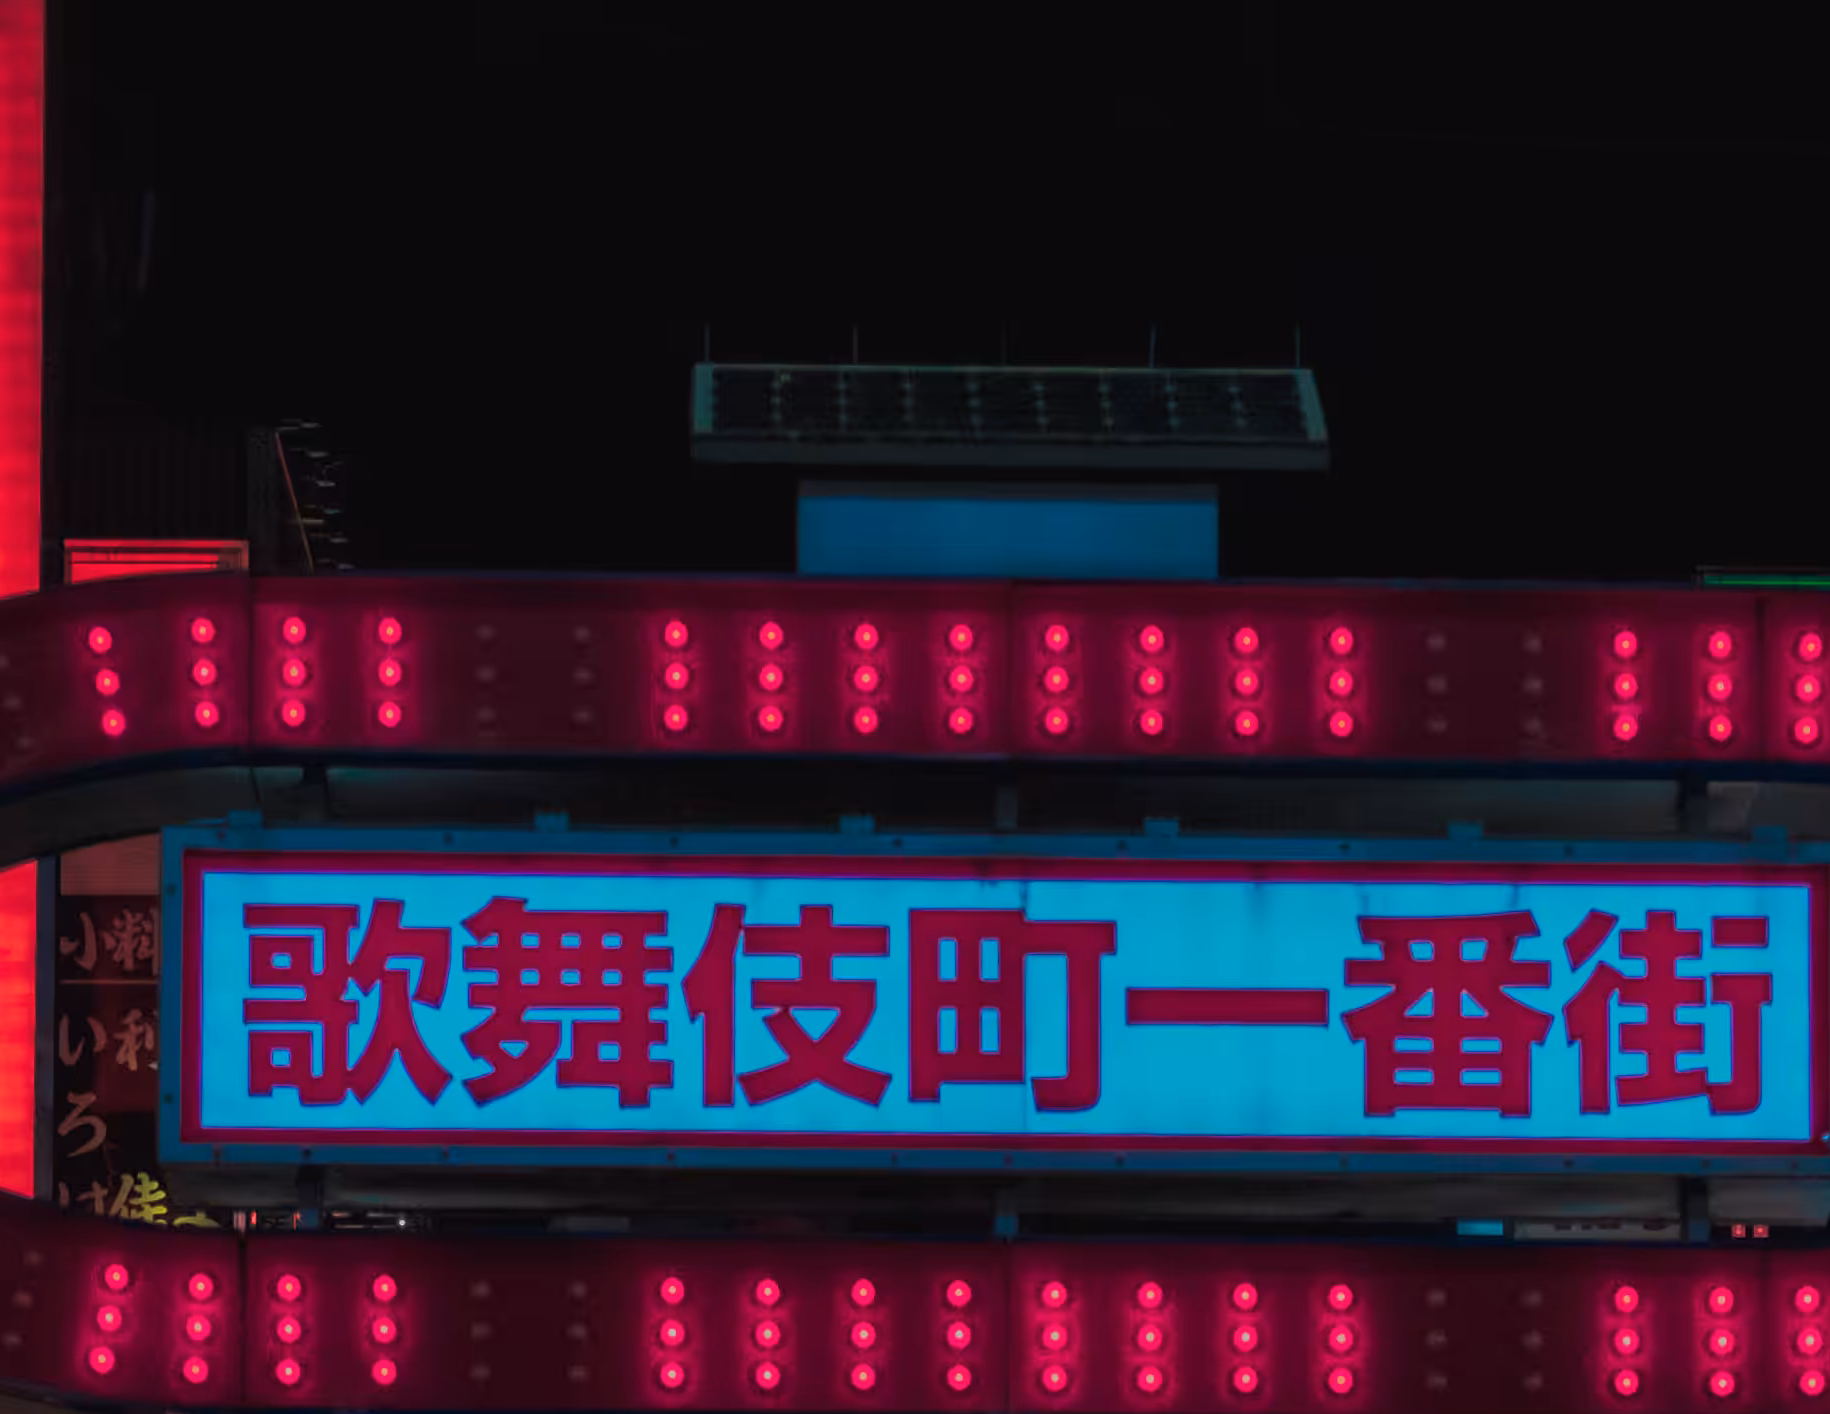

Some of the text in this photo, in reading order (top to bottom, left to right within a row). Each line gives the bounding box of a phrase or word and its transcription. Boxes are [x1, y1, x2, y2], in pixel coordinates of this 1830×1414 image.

[242, 896, 1773, 1119] 歌舞伎町一番街
